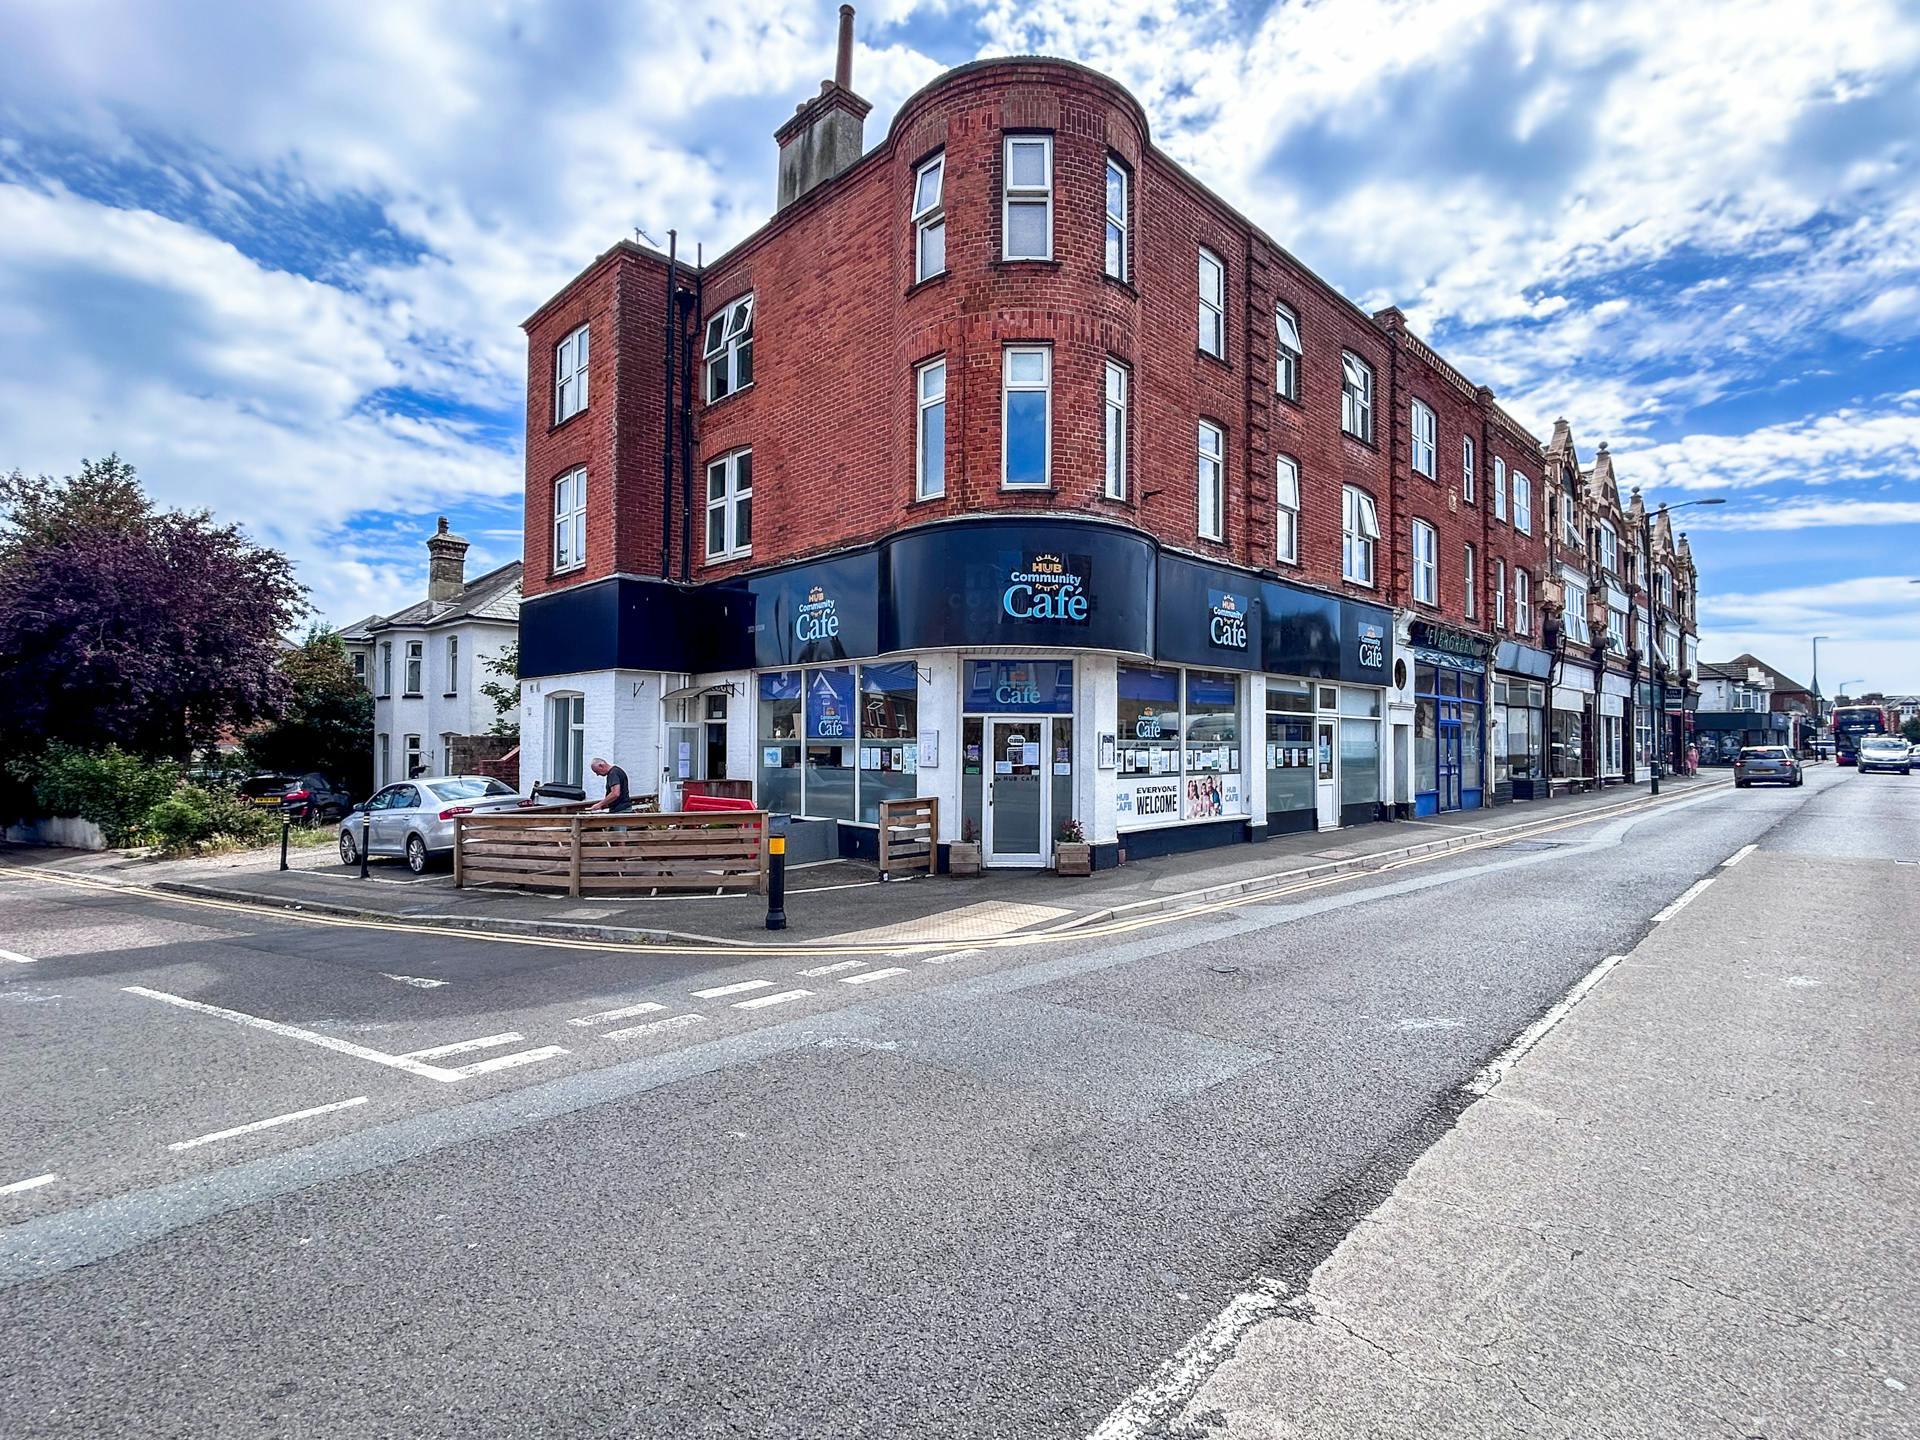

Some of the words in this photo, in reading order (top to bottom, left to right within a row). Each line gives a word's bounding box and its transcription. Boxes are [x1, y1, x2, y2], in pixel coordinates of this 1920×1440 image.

[1032, 562, 1063, 573] HUB
[1011, 571, 1082, 586] Community
[799, 599, 835, 612] Community
[808, 592, 824, 602] HUB
[1003, 584, 1088, 620] Café
[1222, 600, 1235, 610] HUB
[1213, 606, 1245, 621] Community
[796, 608, 839, 641] Café
[1210, 616, 1247, 648] Café
[1359, 643, 1383, 668] Café
[995, 686, 1041, 704] Café
[818, 719, 843, 736] Café
[1136, 720, 1161, 738] Café
[1136, 785, 1177, 794] EVERYONE
[1136, 793, 1178, 815] WELCOME
